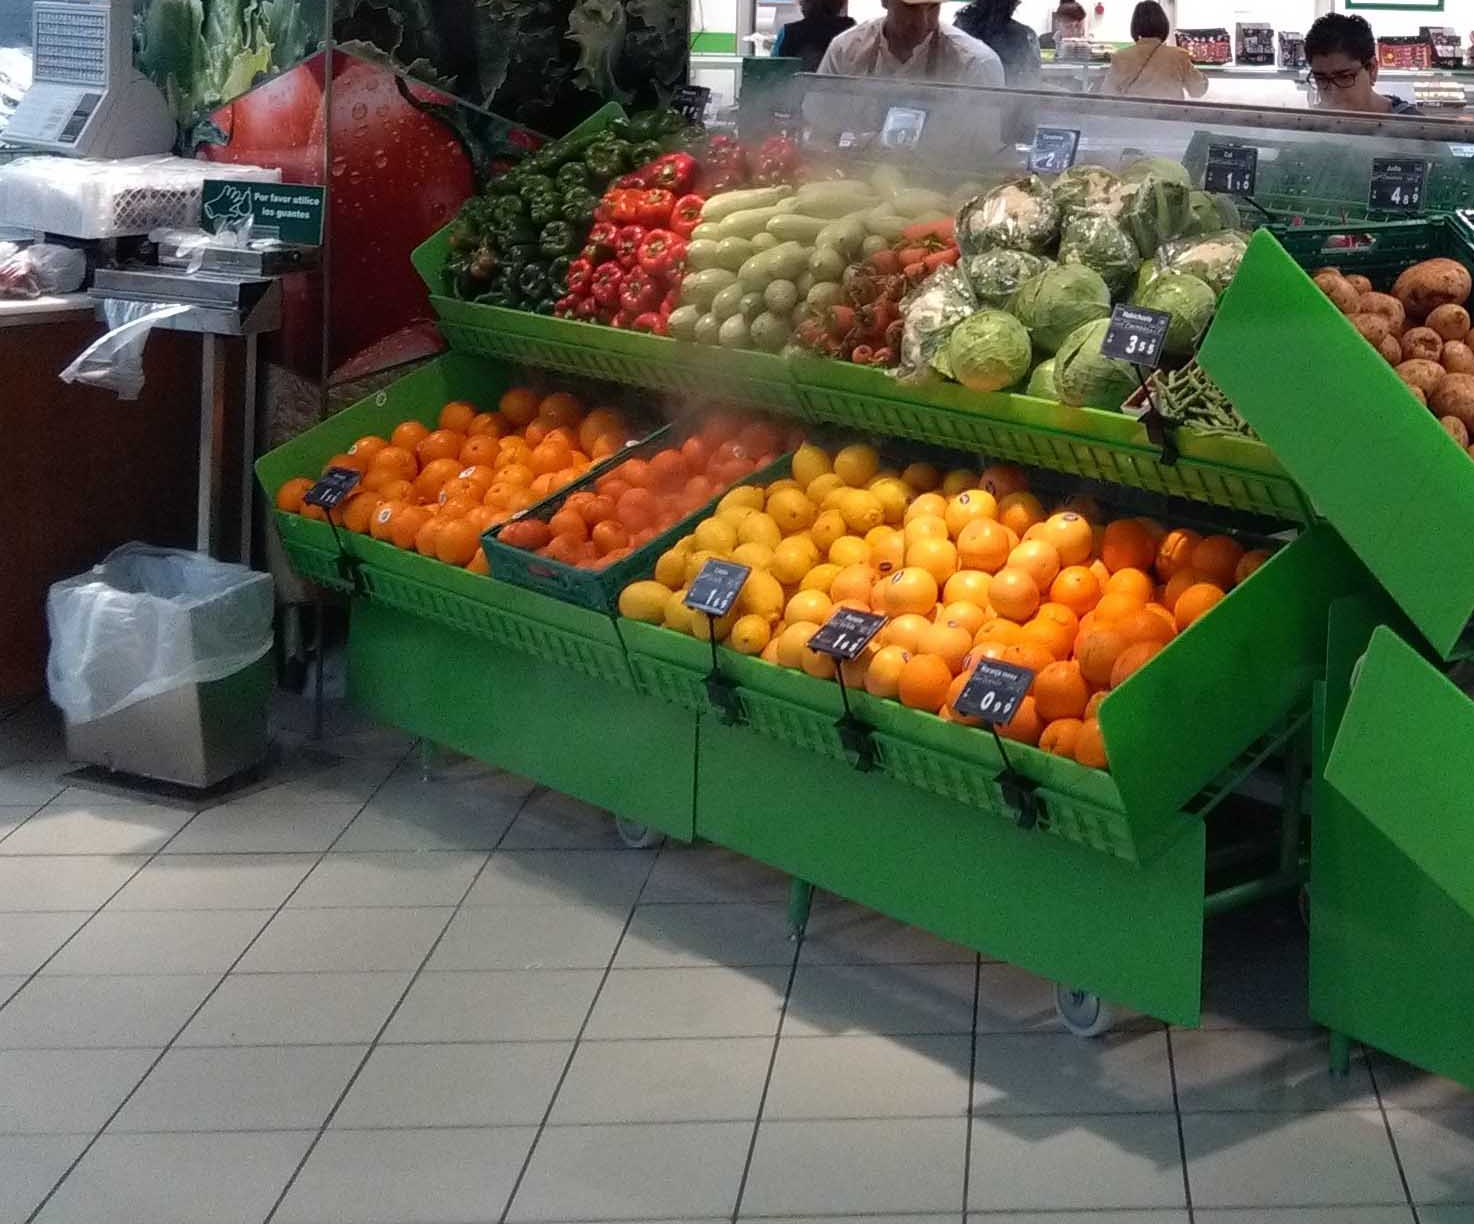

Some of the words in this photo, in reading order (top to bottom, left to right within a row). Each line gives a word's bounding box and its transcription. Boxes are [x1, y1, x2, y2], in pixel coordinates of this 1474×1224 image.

[254, 192, 268, 202] Por
[270, 193, 292, 204] favor
[292, 195, 320, 206] utilice
[261, 207, 274, 217] los
[276, 210, 310, 220] guantes
